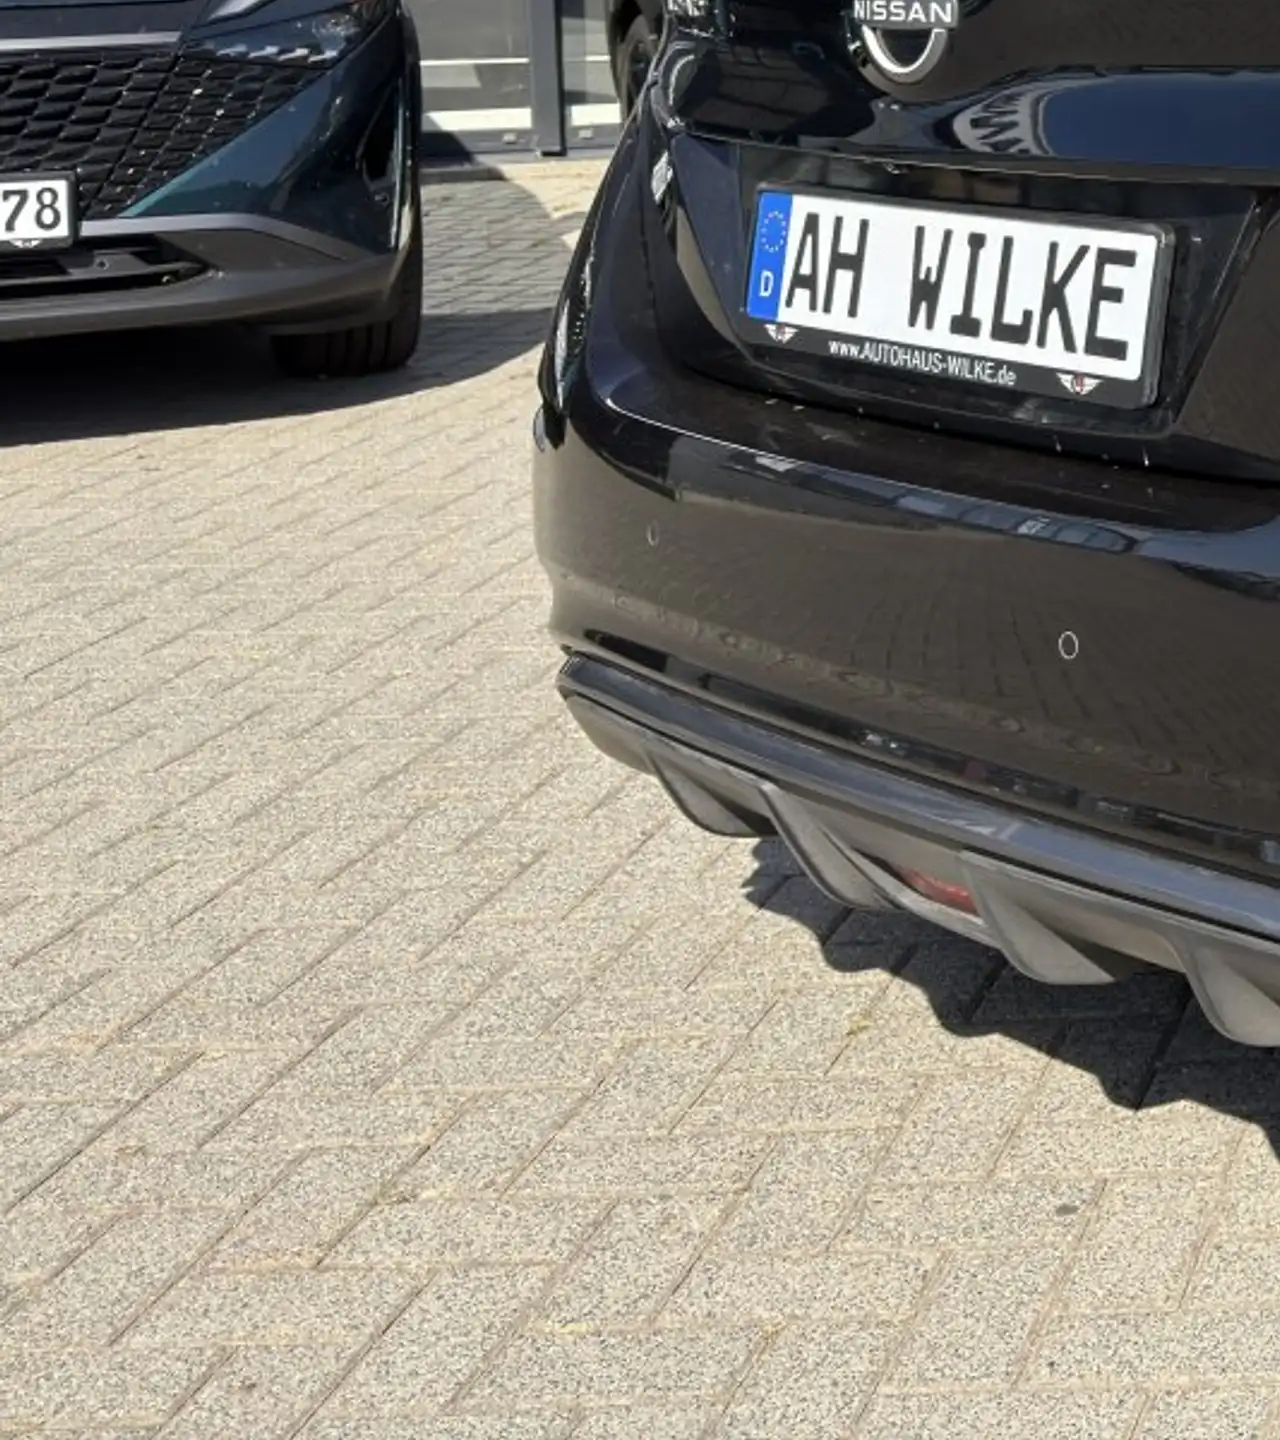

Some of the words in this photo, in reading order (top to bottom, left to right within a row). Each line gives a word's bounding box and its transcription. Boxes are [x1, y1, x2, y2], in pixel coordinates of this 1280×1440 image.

[2, 186, 62, 233] 78
[758, 270, 774, 298] D
[784, 211, 870, 319] AH
[907, 225, 1138, 362] WILKE
[828, 339, 1016, 387] www.AUTOHAUS-WILKE.de
